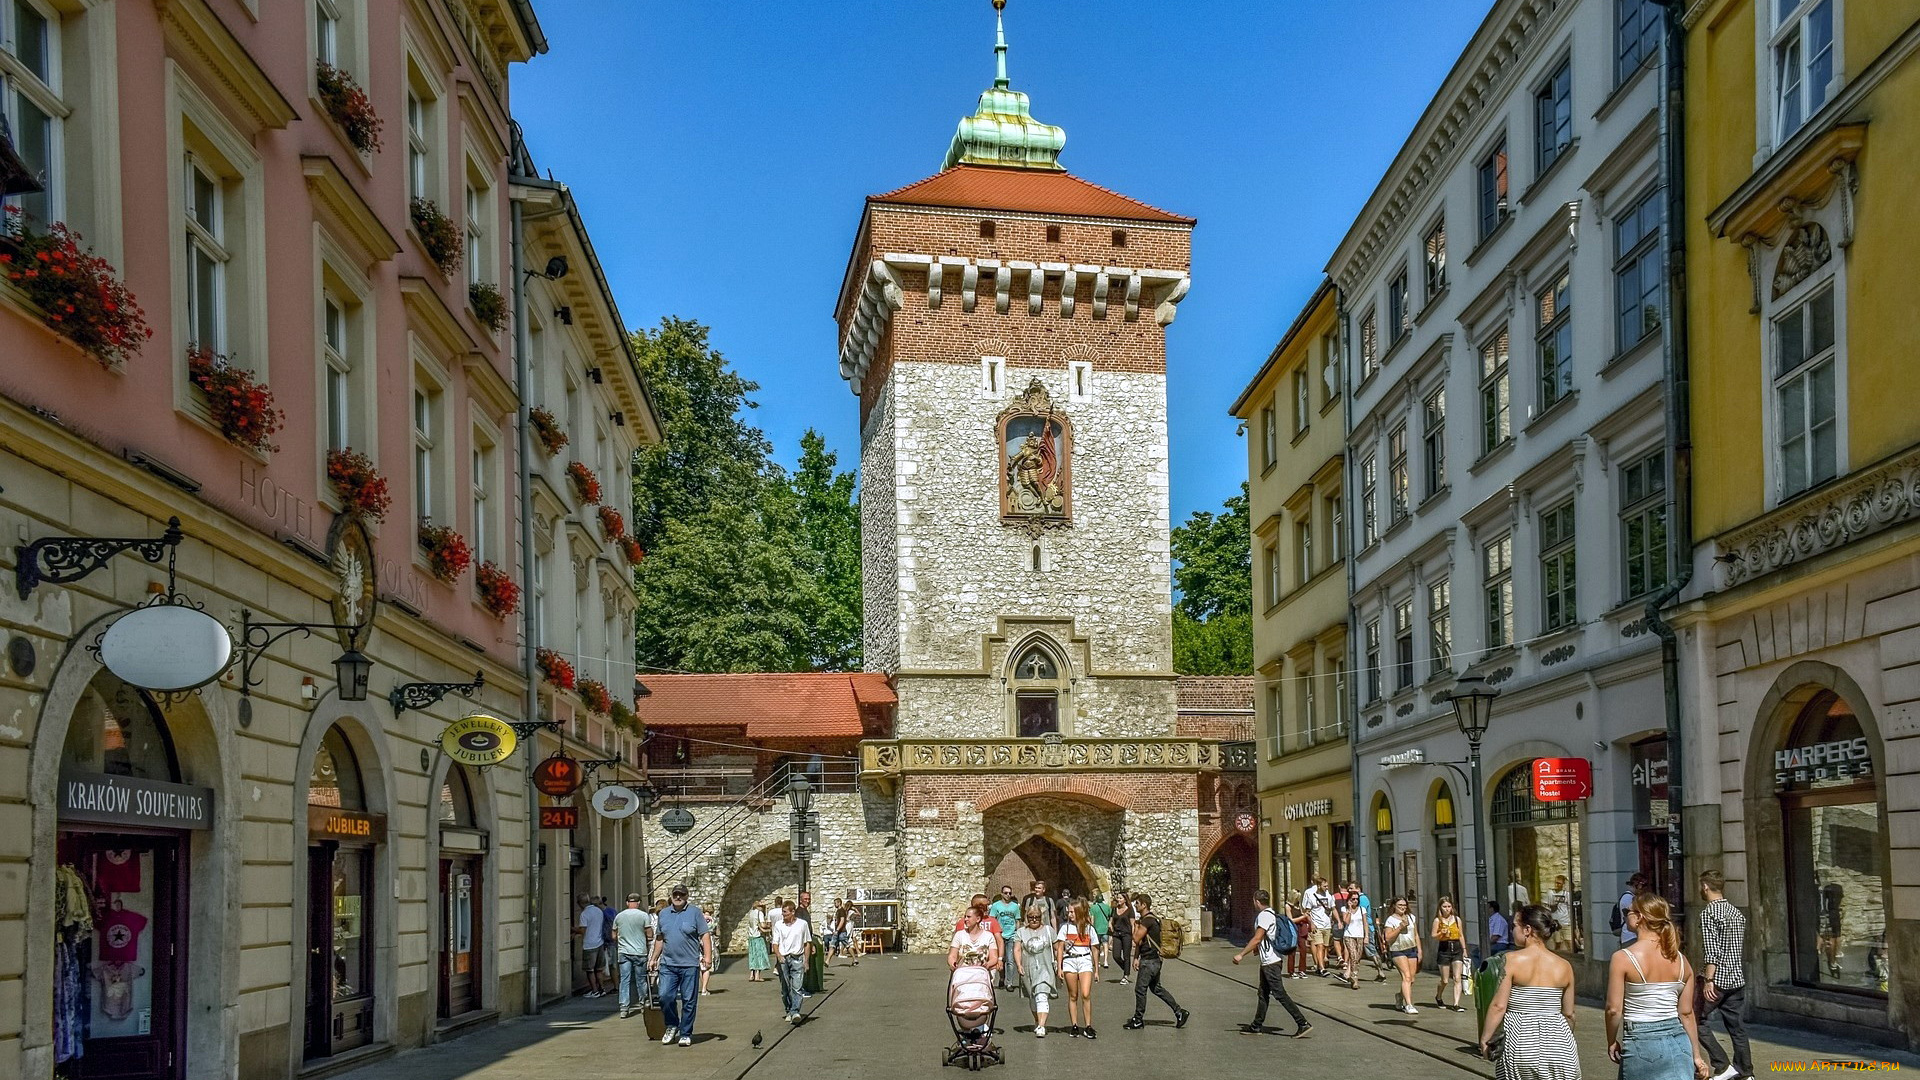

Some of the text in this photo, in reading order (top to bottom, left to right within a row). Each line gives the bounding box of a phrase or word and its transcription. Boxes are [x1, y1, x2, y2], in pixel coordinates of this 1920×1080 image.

[239, 460, 318, 547] HOTEL
[355, 674, 368, 686] 42
[449, 720, 510, 738] JEWELLERY
[454, 748, 506, 761] JUBILER
[1775, 737, 1868, 770] HARPERS
[1775, 761, 1871, 784] SHOES
[68, 779, 203, 821] KRAKÓW SOUVENIRS
[1284, 798, 1329, 821] COSTA COFFEE
[326, 816, 371, 836] JUBILER
[542, 811, 574, 826] 24 h
